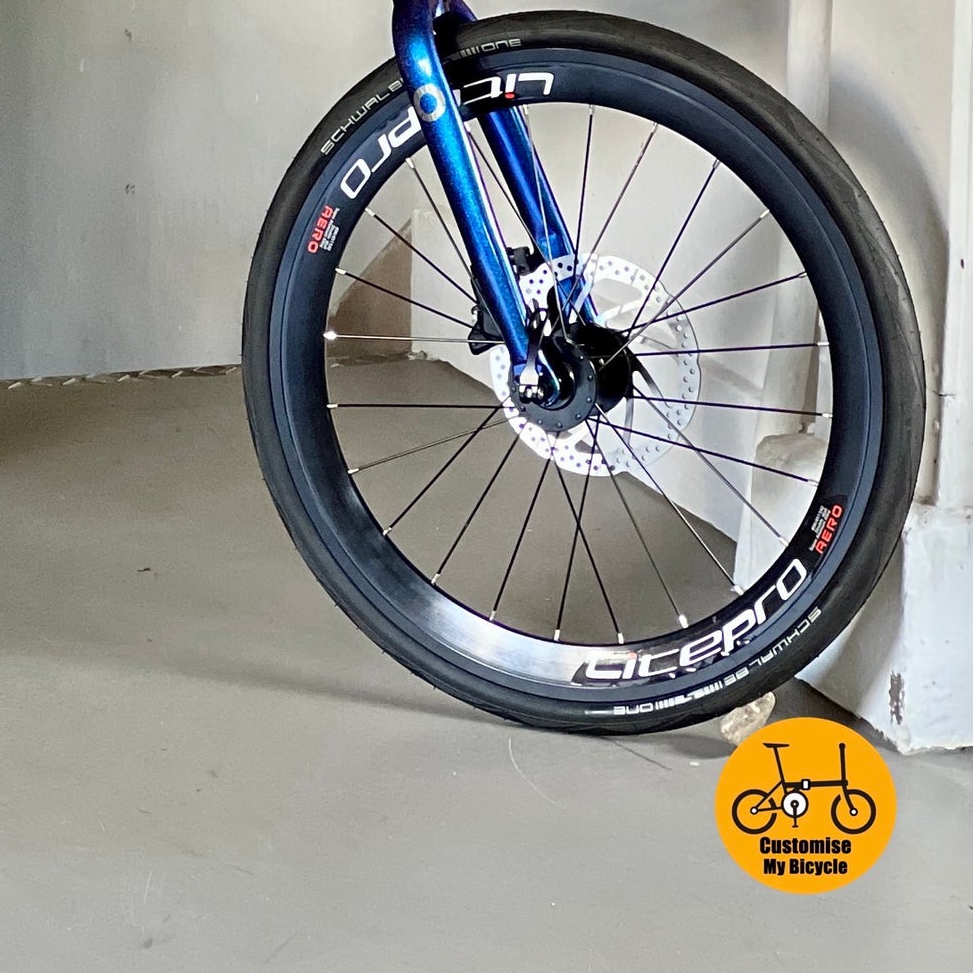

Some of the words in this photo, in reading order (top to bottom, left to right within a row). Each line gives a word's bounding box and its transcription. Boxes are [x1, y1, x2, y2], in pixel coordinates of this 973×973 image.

[320, 77, 405, 156] SCHWALB
[480, 38, 523, 53] ONE
[340, 72, 555, 199] Litpro
[307, 205, 334, 254] AERO
[815, 504, 843, 555] AERO
[725, 607, 822, 687] SCHWALBE
[613, 703, 655, 716] ONE
